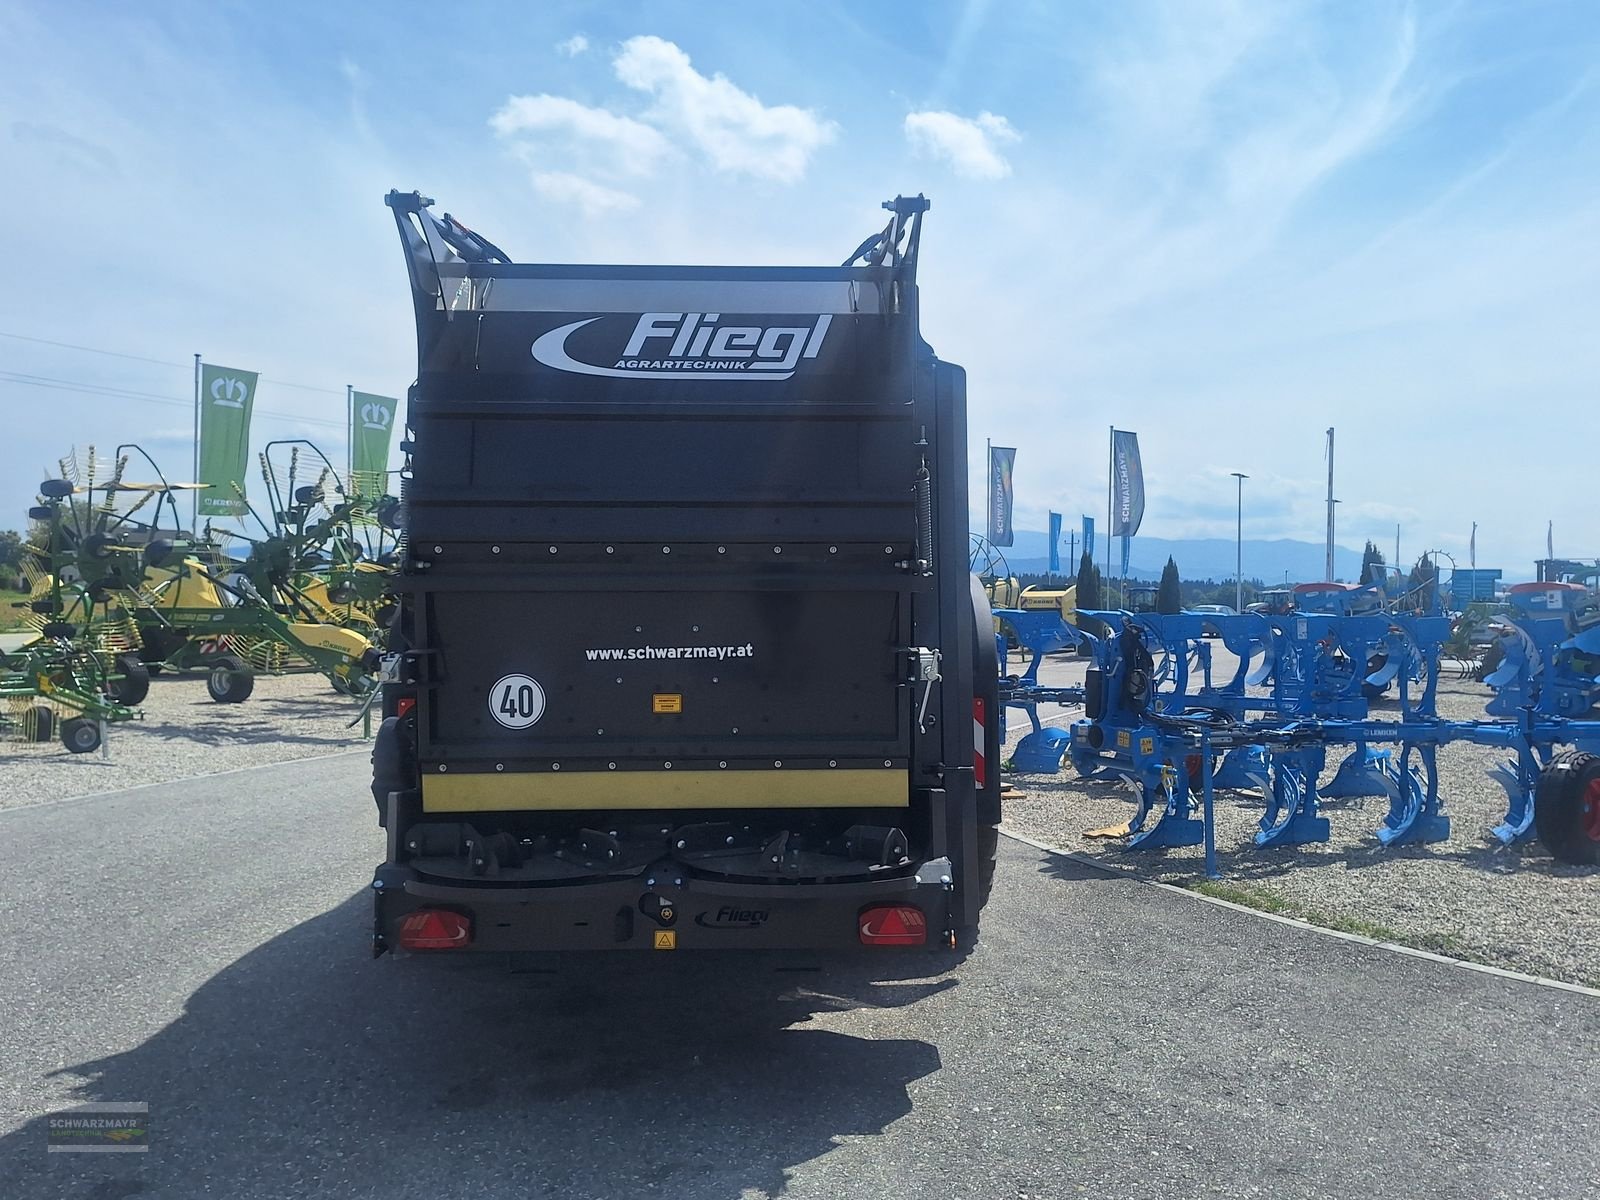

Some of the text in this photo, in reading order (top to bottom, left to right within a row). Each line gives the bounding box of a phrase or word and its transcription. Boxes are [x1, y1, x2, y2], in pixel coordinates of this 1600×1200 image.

[622, 313, 833, 369] Fliegl
[614, 359, 748, 370] AGRARTECHNIK
[1119, 452, 1130, 523] SCHWARZMAYR
[585, 643, 753, 661] www.schwarzmayr.at
[500, 685, 533, 718] 40
